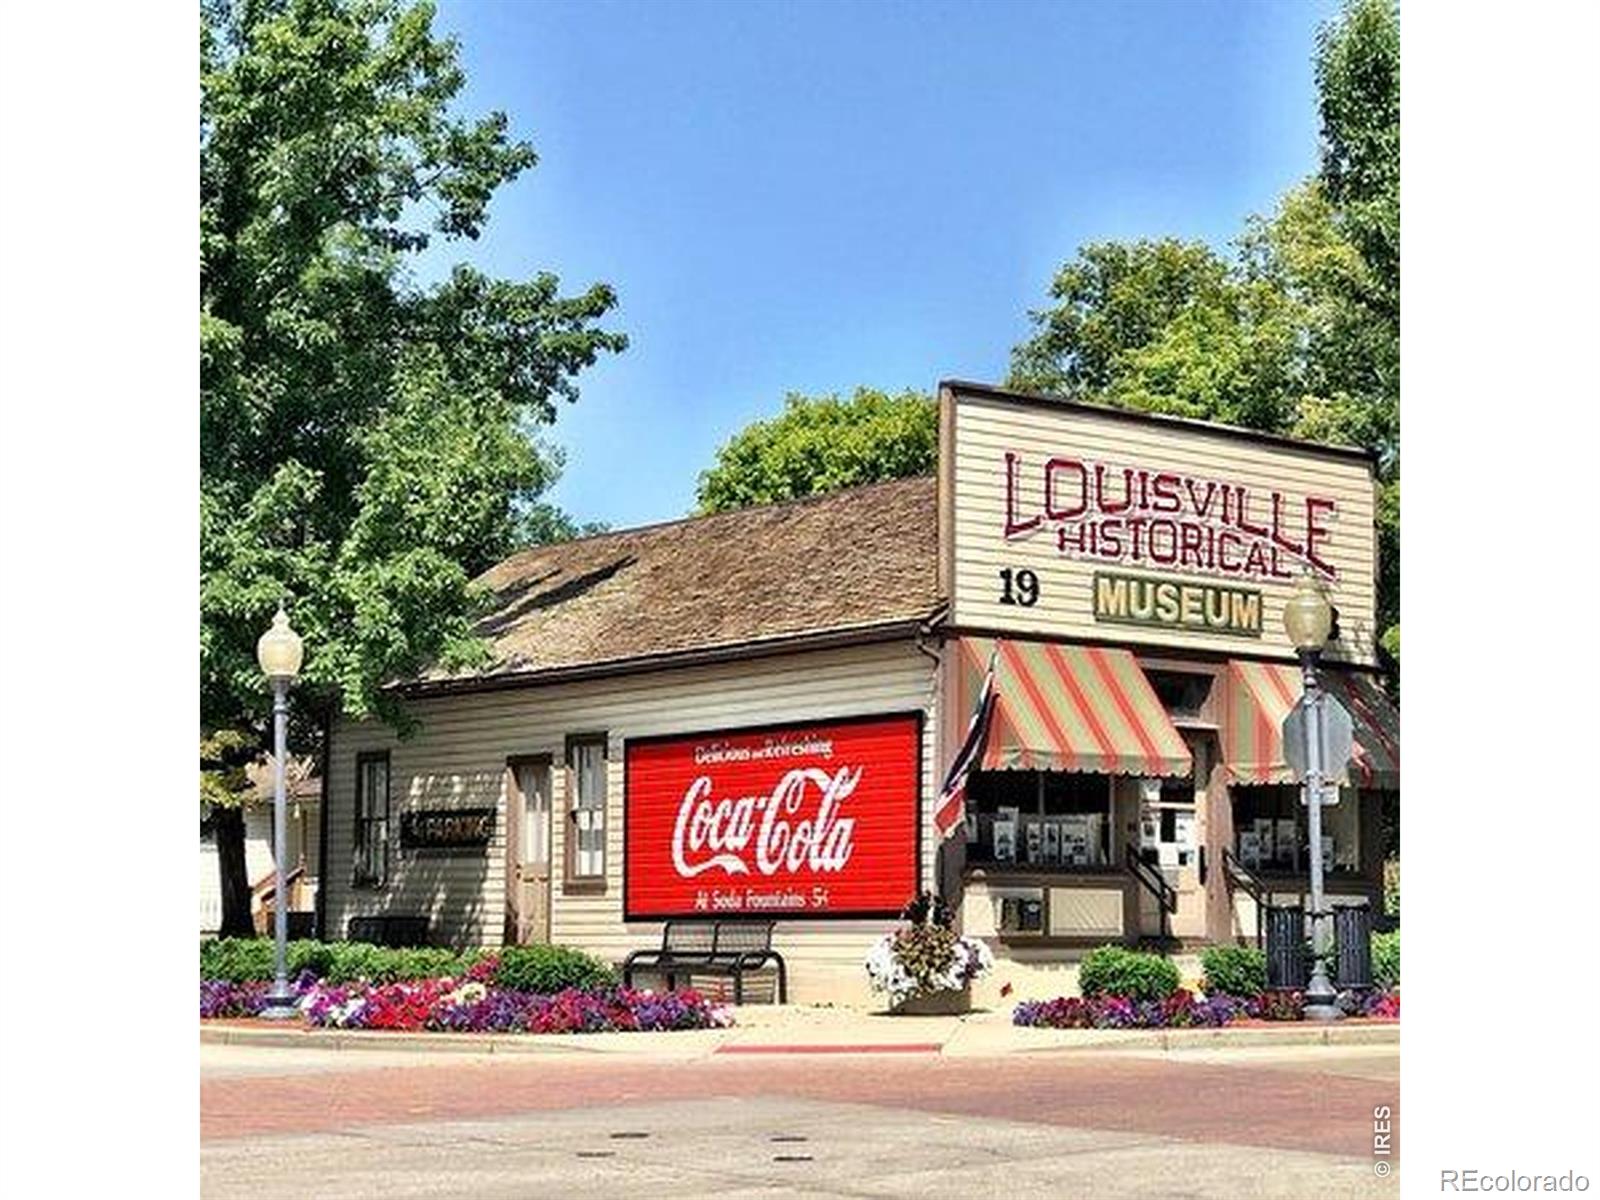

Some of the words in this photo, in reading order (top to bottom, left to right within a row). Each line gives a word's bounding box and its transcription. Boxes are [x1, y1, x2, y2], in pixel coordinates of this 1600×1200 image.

[1003, 451, 1337, 581] LOUISVILLE
[1056, 517, 1293, 580] HISTORICAL
[998, 568, 1040, 607] 19
[1098, 576, 1260, 631] MUSEUM
[695, 741, 751, 765] Delicious
[671, 764, 864, 878] Coca-Cola
[711, 888, 743, 911] Soda
[746, 886, 806, 909] Fountains
